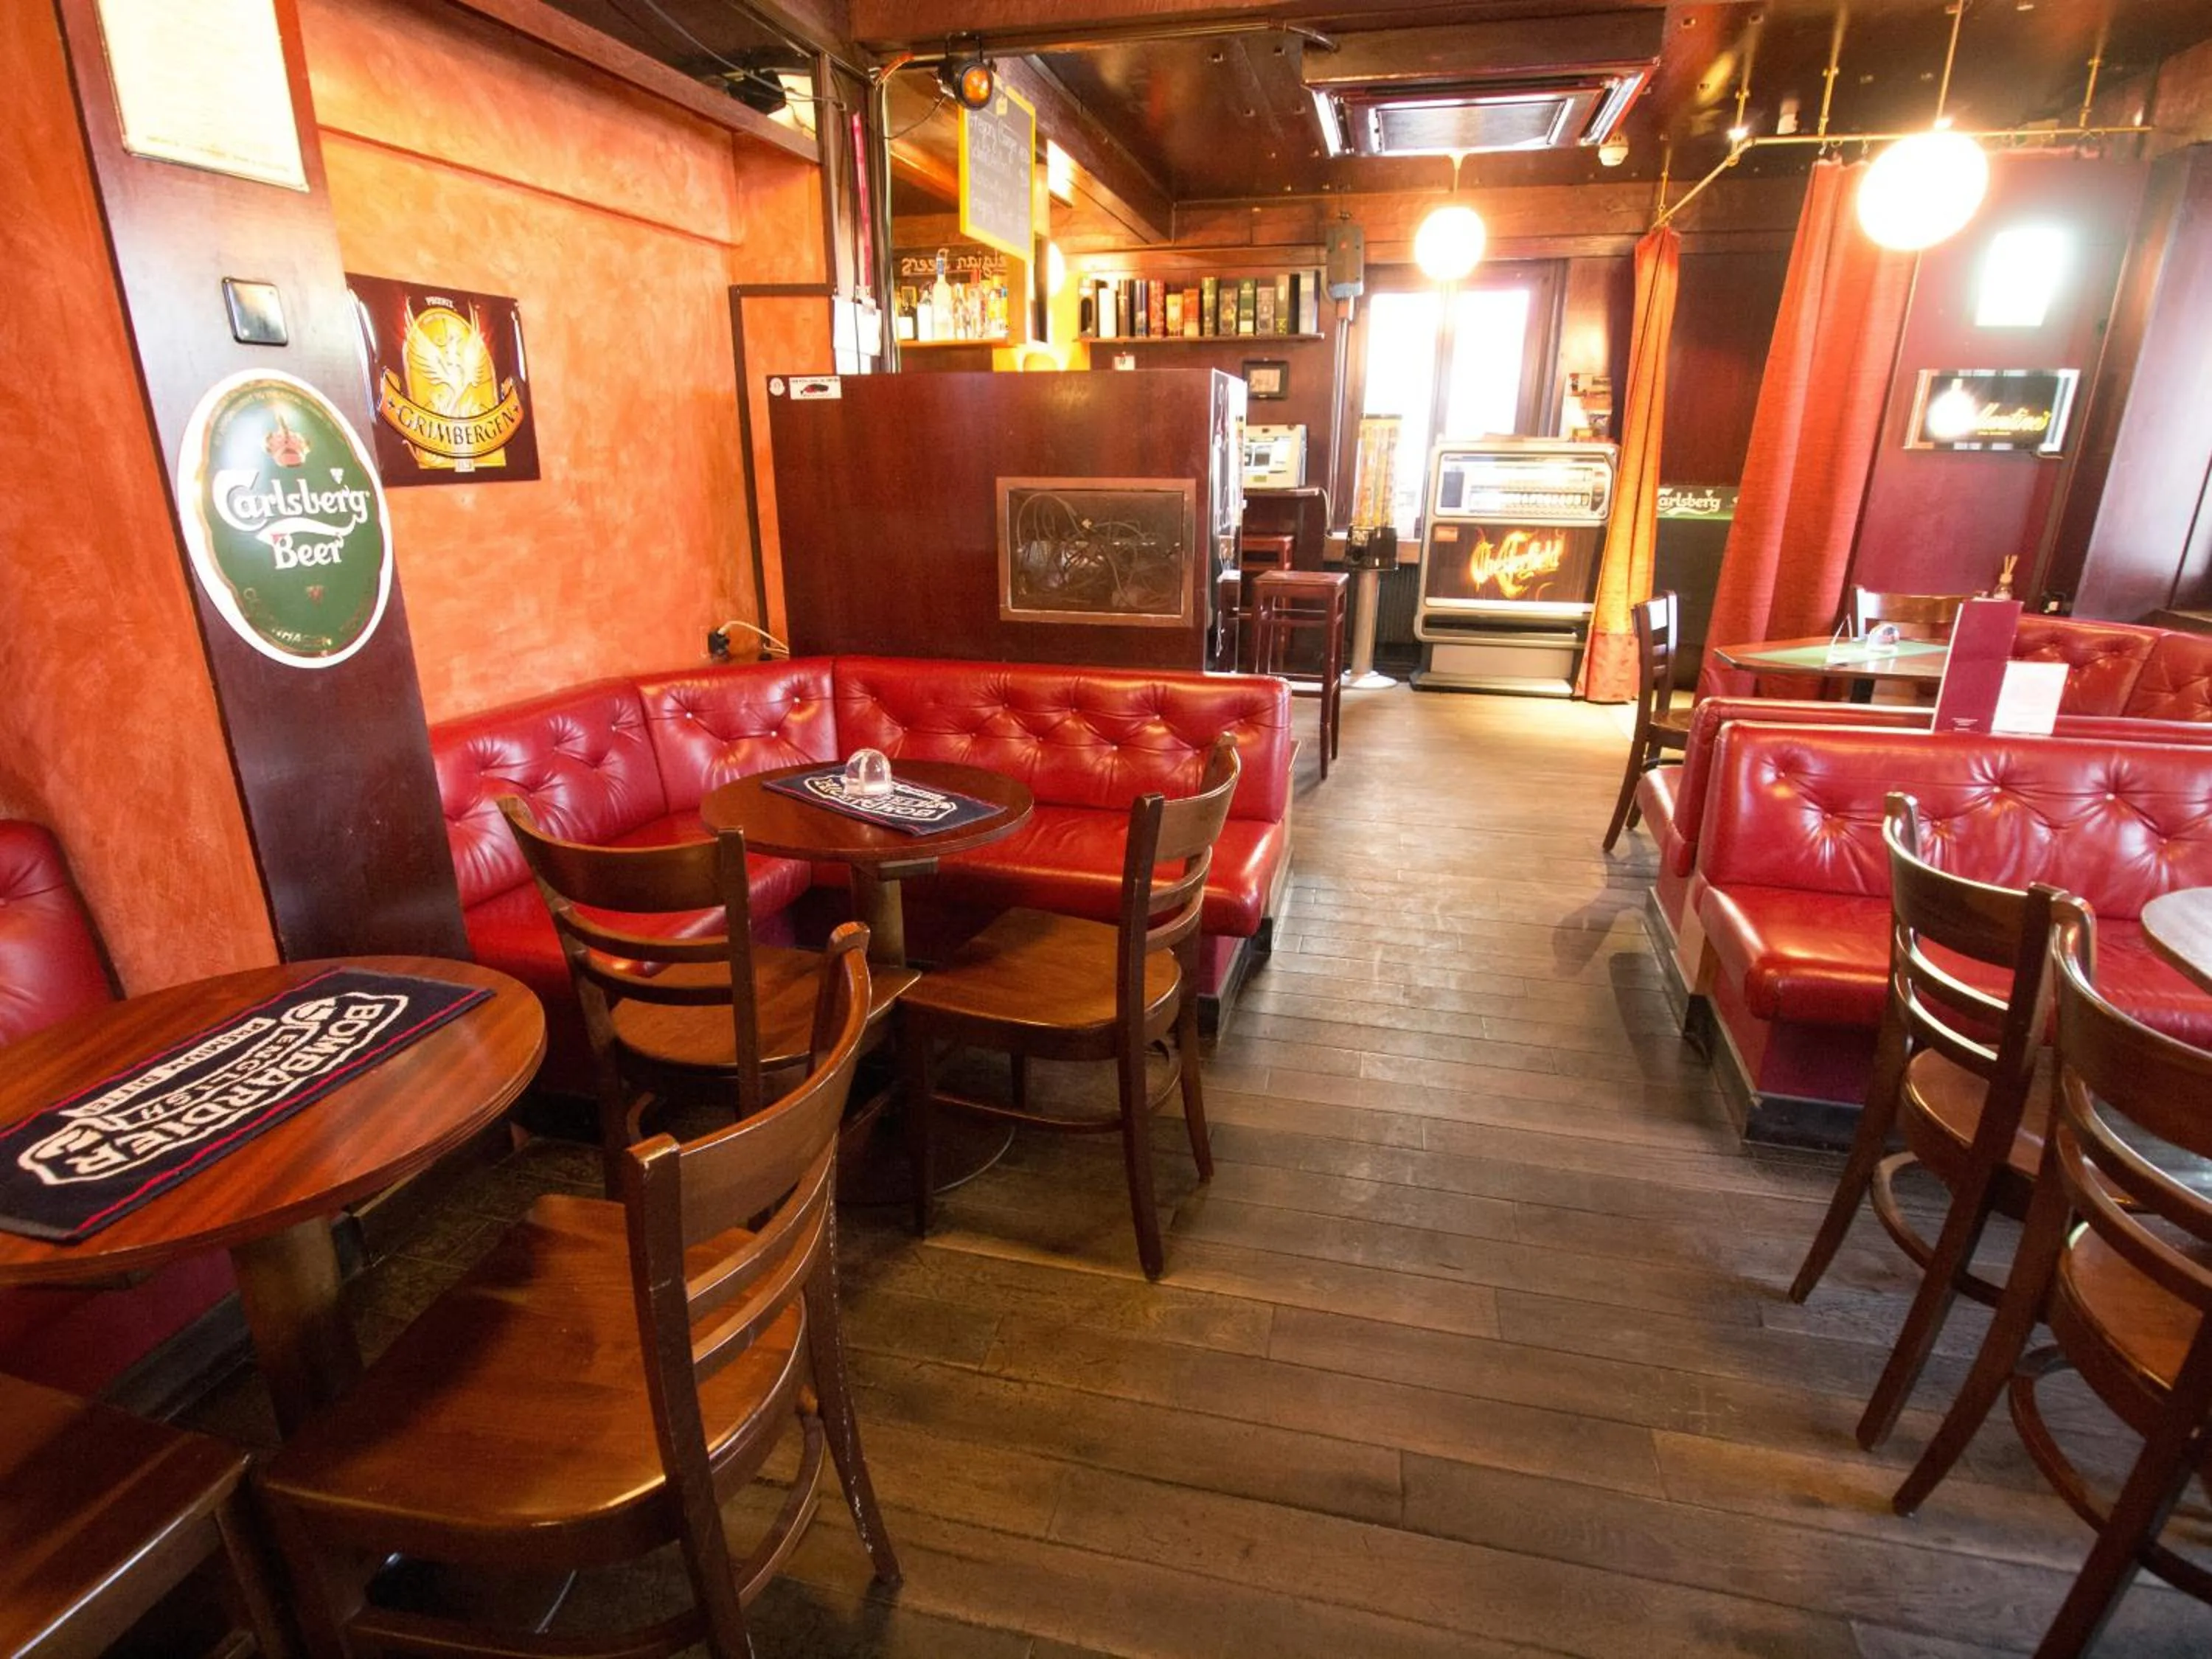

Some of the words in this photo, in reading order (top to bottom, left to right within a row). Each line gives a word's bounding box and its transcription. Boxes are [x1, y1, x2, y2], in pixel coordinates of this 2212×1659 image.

[397, 407, 517, 445] GRIMBERGEN
[212, 469, 370, 531] Carlsberg
[273, 532, 344, 569] Beer
[163, 1022, 264, 1071] PREMIUM
[65, 1004, 386, 1175] BOMBARDIER
[139, 1034, 298, 1121] ENGLISH
